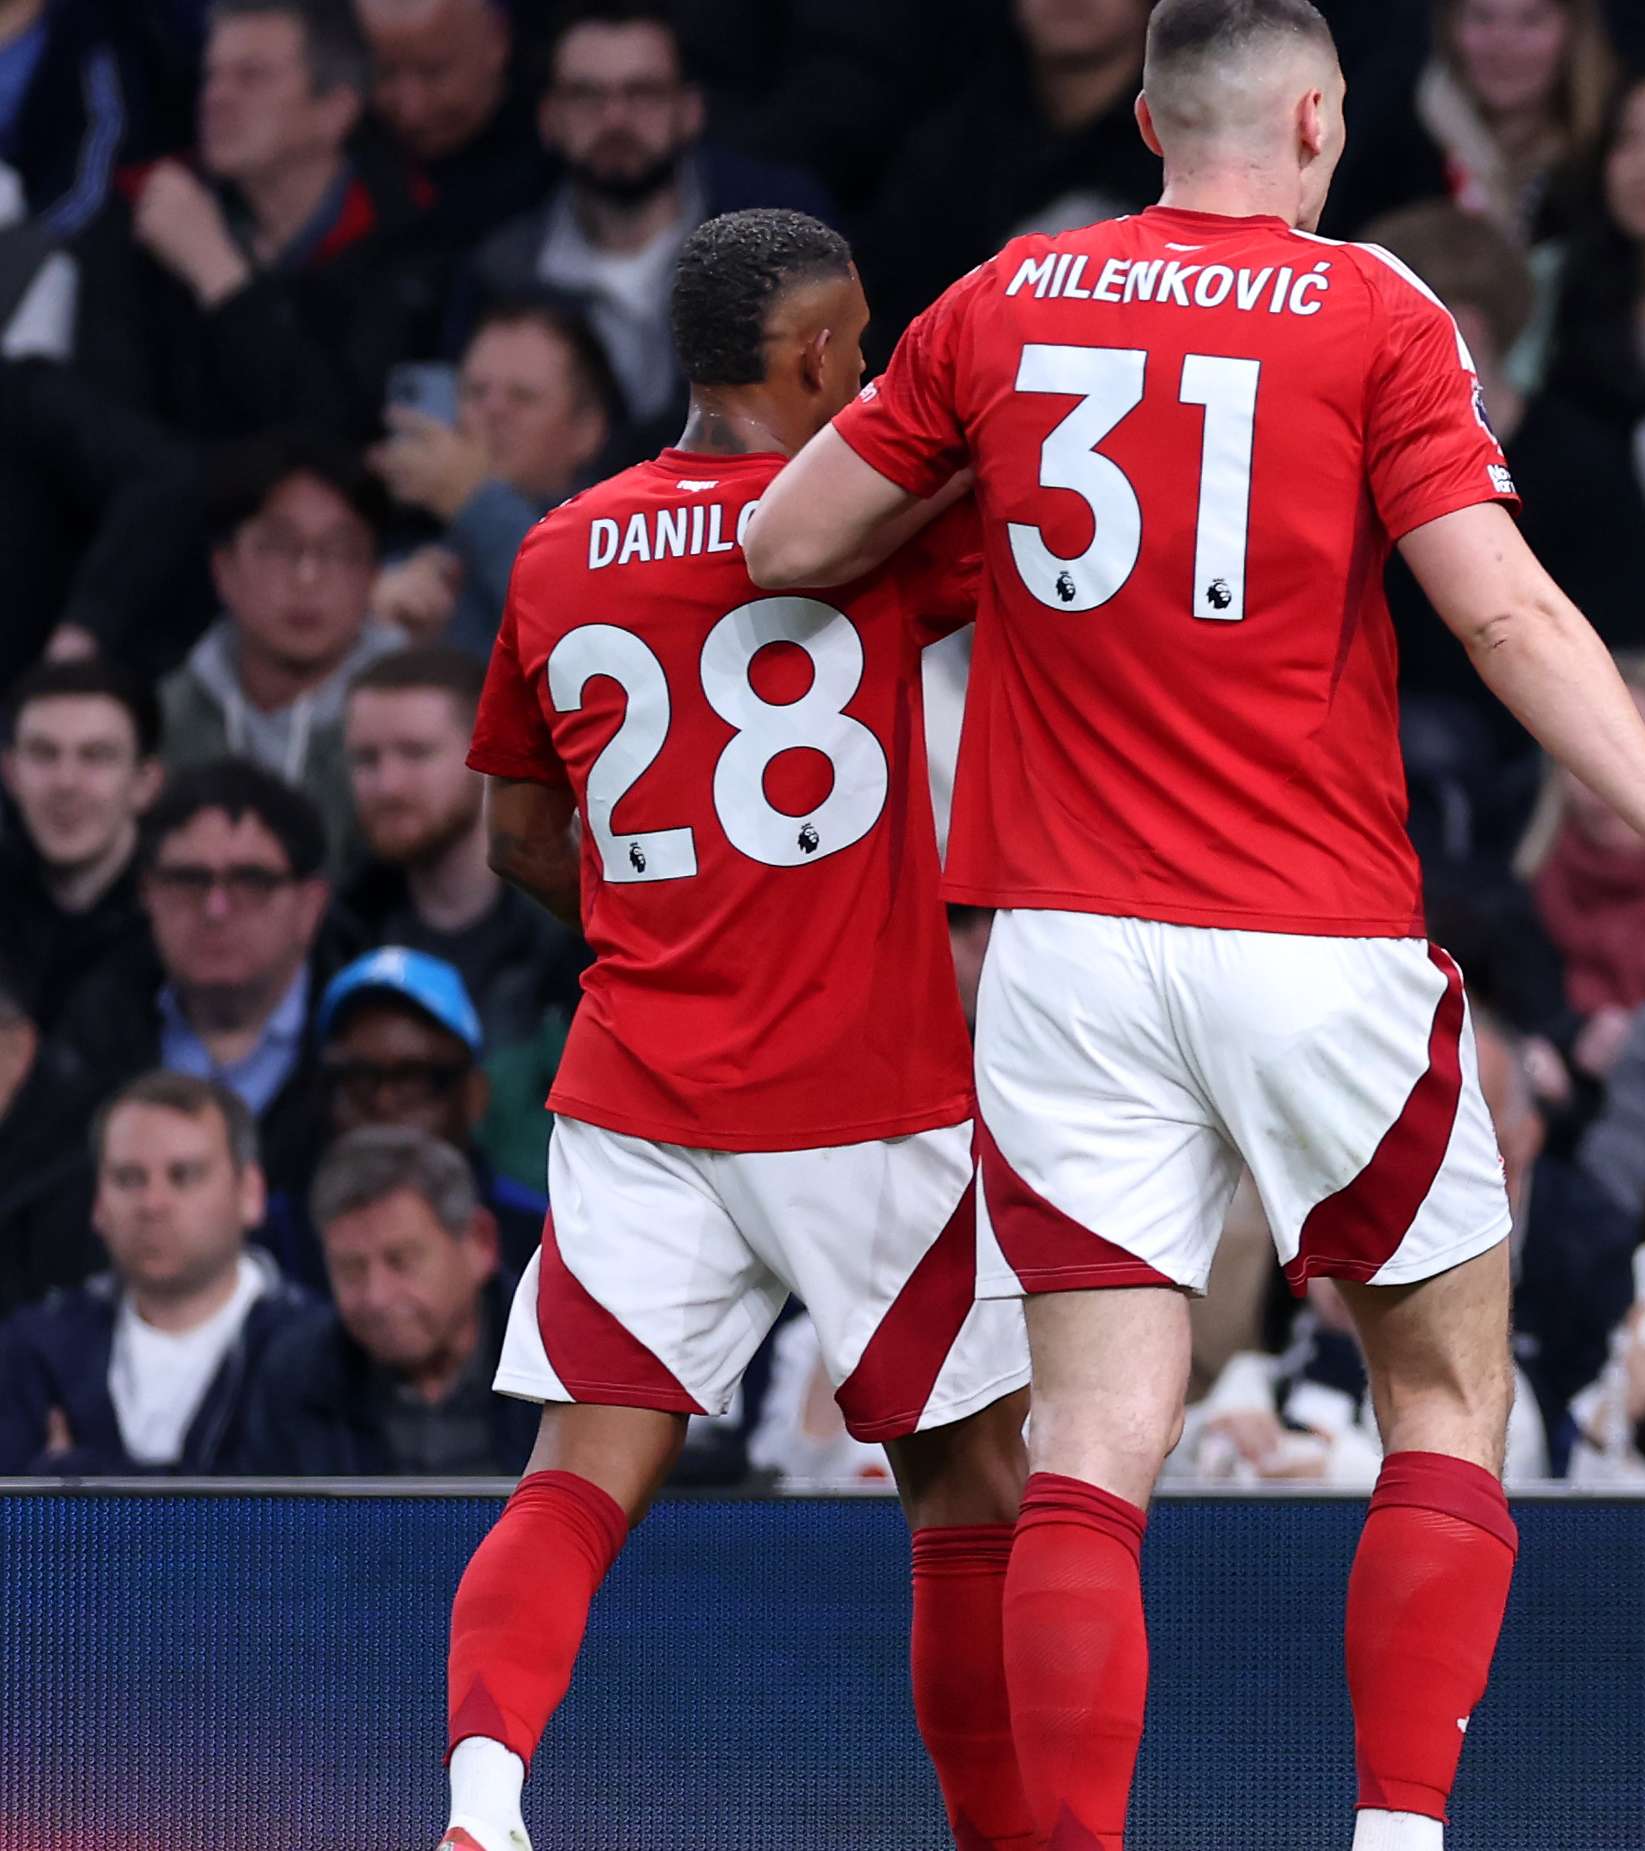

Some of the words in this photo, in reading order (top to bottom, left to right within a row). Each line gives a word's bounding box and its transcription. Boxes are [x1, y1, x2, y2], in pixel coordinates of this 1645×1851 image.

[1005, 253, 1331, 316] MILENKOVIĆ
[1007, 343, 1262, 621] 31
[547, 595, 889, 883] 28
